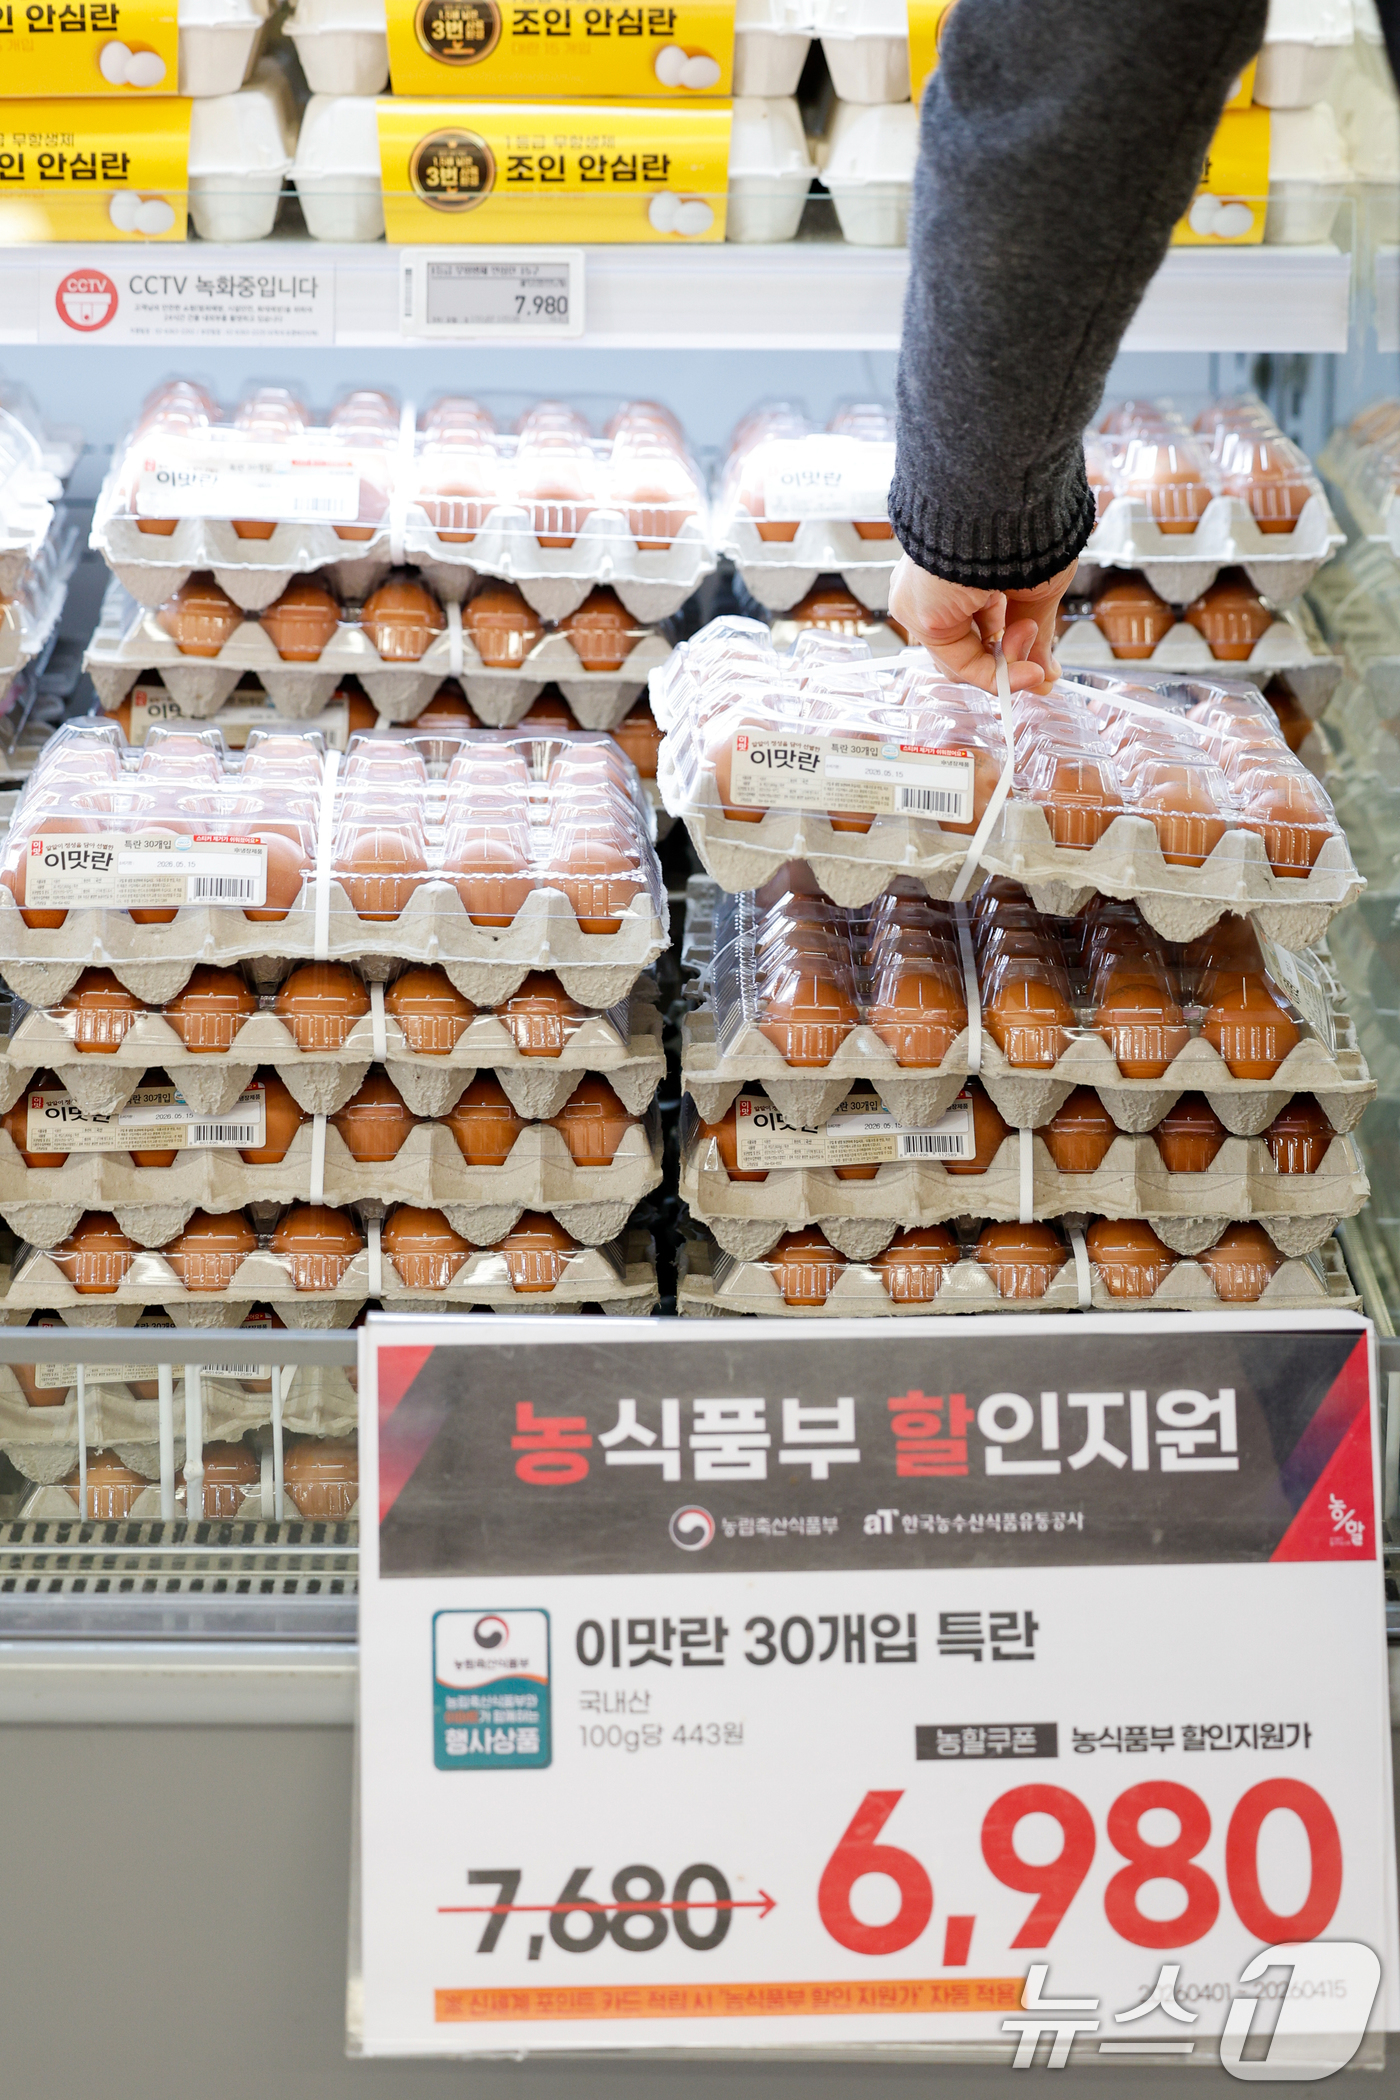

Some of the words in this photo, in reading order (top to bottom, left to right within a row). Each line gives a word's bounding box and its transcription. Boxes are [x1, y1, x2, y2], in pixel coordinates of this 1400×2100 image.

[26, 3, 120, 33] 안심란
[512, 8, 571, 36] 조인
[585, 8, 678, 36] 안심란
[12, 133, 75, 148] 무항생제
[37, 152, 130, 181] 안심란
[506, 155, 565, 182] 조인
[578, 154, 671, 182] 안심란
[67, 278, 107, 293] CCTV
[129, 275, 188, 295] CCTV
[195, 274, 319, 298] 녹화중입니다
[750, 748, 821, 773] 이맛란
[831, 743, 849, 754] 특란
[851, 745, 878, 757] 30개입
[124, 840, 142, 850] 특란
[144, 840, 172, 850] 30개입
[44, 850, 114, 872] 이맛란
[143, 1092, 171, 1103] 30개입
[850, 1100, 878, 1111] 30개입
[511, 1397, 861, 1486] 농식품부
[887, 1388, 1240, 1478] 할인지원
[721, 1516, 839, 1537] 농림축산식품부
[901, 1511, 1085, 1534] 한국농수산식품유통공사
[575, 1616, 729, 1668] 이맛란
[743, 1612, 918, 1665] 30개입
[936, 1610, 1039, 1663] 특란
[578, 1689, 651, 1716] 국내산
[444, 1726, 540, 1756] 행사상품
[579, 1724, 664, 1752] 100g당
[672, 1722, 745, 1748] 443원
[936, 1725, 1037, 1756] 농할쿠폰
[1071, 1724, 1176, 1754] 농식품부
[1181, 1722, 1312, 1752] 할인지원가
[817, 1776, 1344, 1967] 6,980
[467, 1861, 733, 1961] 7,680
[469, 1992, 530, 2015] 신세계
[537, 1991, 596, 2013] 포인트
[602, 1991, 643, 2012] 카드
[648, 1990, 688, 2011] 적립
[694, 1990, 713, 2010] 시
[812, 1986, 851, 2008] 할인
[930, 1984, 969, 2006] 자동
[975, 1983, 1016, 2006] 적용
